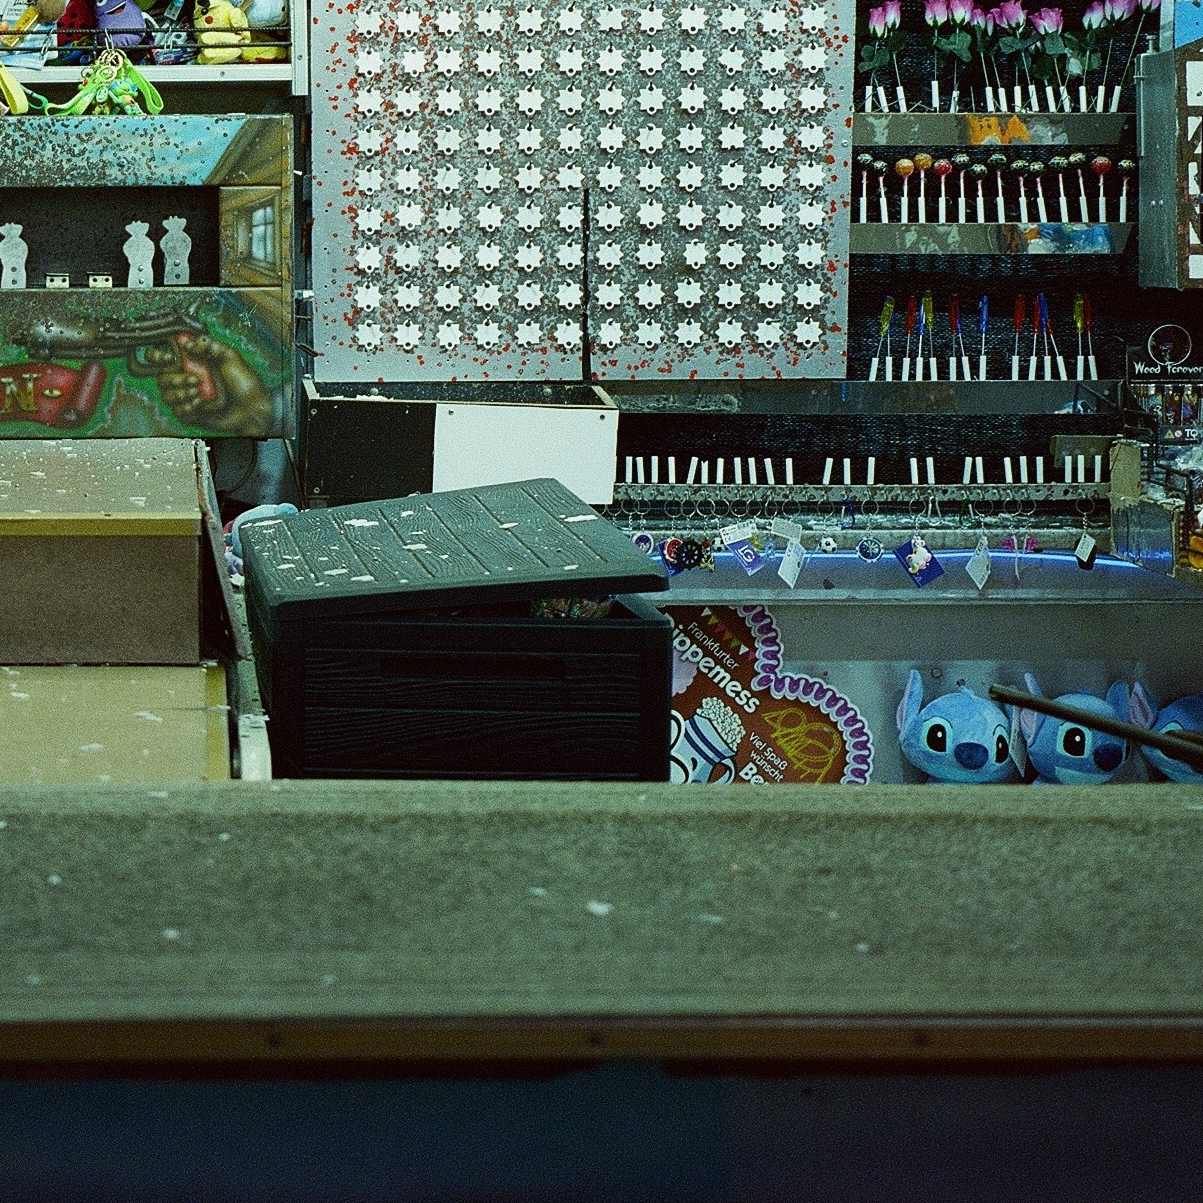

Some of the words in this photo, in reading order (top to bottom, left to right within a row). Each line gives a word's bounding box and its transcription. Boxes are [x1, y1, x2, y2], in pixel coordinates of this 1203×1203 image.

[1133, 361, 1161, 375] Weed
[687, 621, 740, 671] Frankfurter
[749, 731, 767, 751] Viel
[763, 747, 789, 772] Spaß
[750, 750, 785, 783] wünscht
[739, 761, 770, 784] Be
